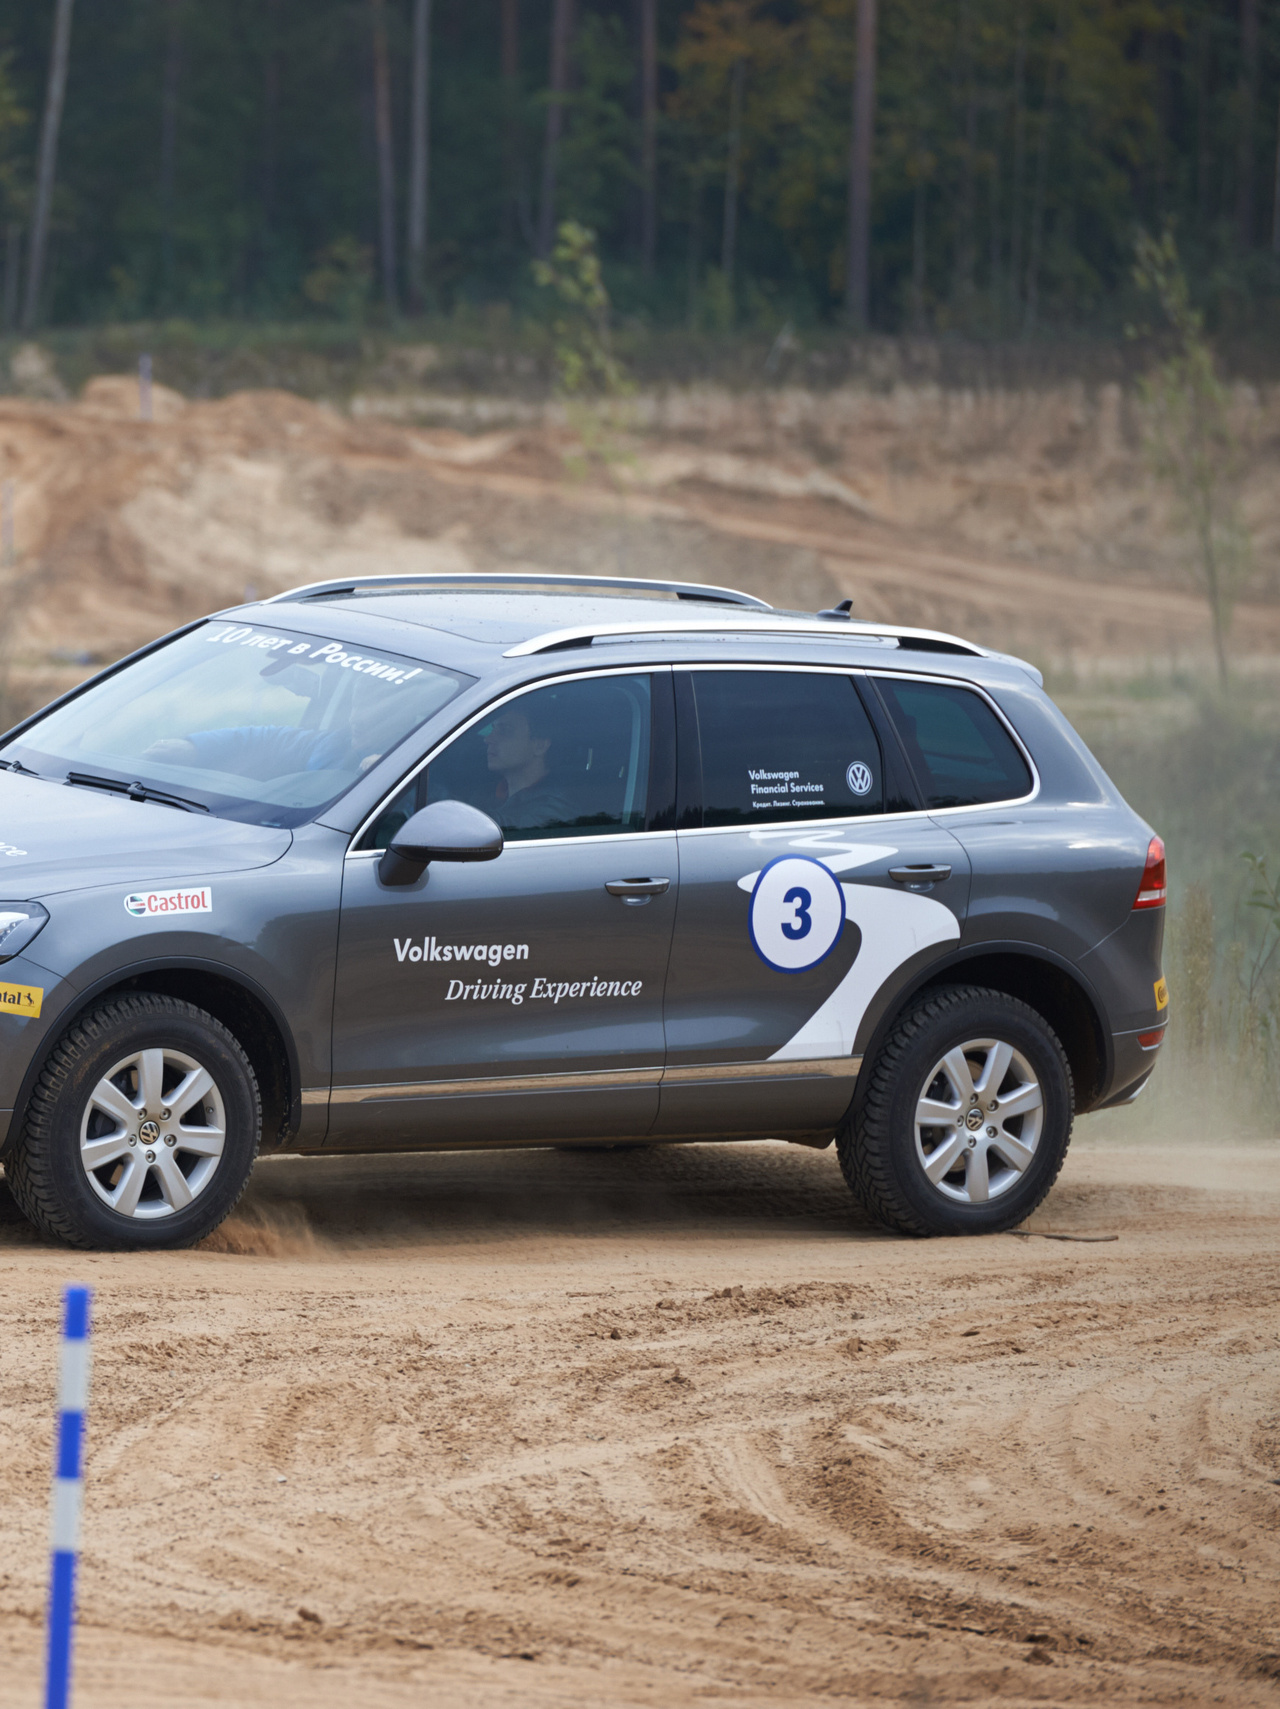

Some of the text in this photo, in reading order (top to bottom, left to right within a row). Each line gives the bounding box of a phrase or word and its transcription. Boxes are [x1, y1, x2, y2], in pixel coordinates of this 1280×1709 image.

[205, 627, 424, 685] 10 лет в России!
[748, 769, 800, 781] Volkswagen
[750, 782, 824, 794] Financial Services
[147, 890, 209, 912] Castrol
[781, 886, 812, 940] 3
[393, 936, 530, 967] Volkswagen
[444, 976, 643, 1005] Driving Experience
